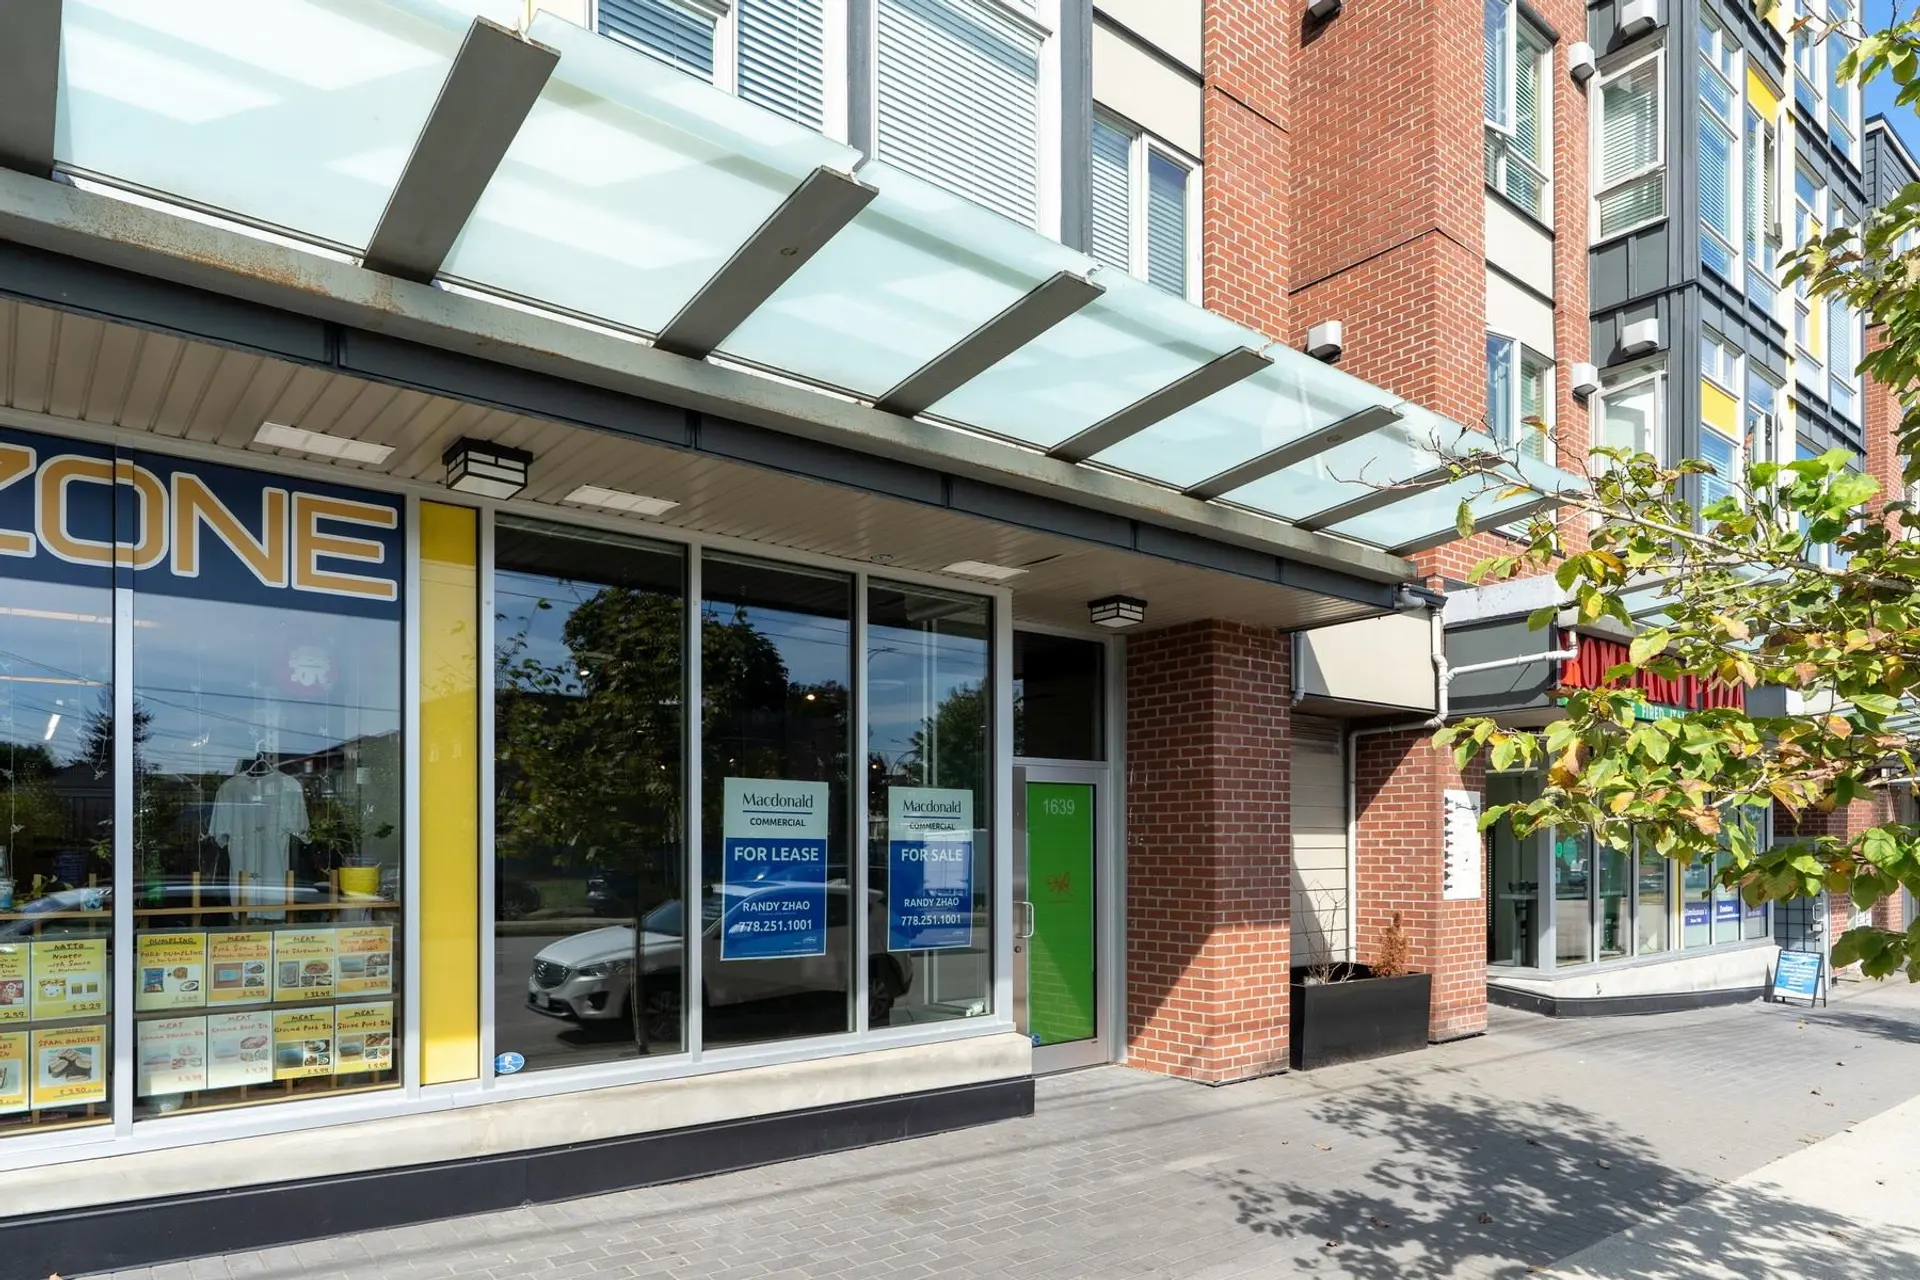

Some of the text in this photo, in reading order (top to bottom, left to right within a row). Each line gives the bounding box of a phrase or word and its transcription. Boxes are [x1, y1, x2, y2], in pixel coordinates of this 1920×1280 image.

[1641, 705, 1665, 719] FIRED
[742, 793, 814, 809] Macdonald
[903, 800, 961, 813] Macdonald
[1043, 799, 1075, 815] 1639
[749, 817, 806, 827] COMMERCIAL
[909, 822, 955, 831] COMMERCIAL
[734, 847, 819, 862] FOR LEASE
[901, 848, 963, 862] FOR SALE
[743, 900, 810, 912] RANDY ZHAO
[904, 897, 960, 908] RANDY ZHAO
[738, 919, 812, 933] 778.251.1001
[901, 914, 961, 927] 778.251.1001
[54, 943, 84, 951] NATTO
[149, 937, 194, 945] DUMPLING
